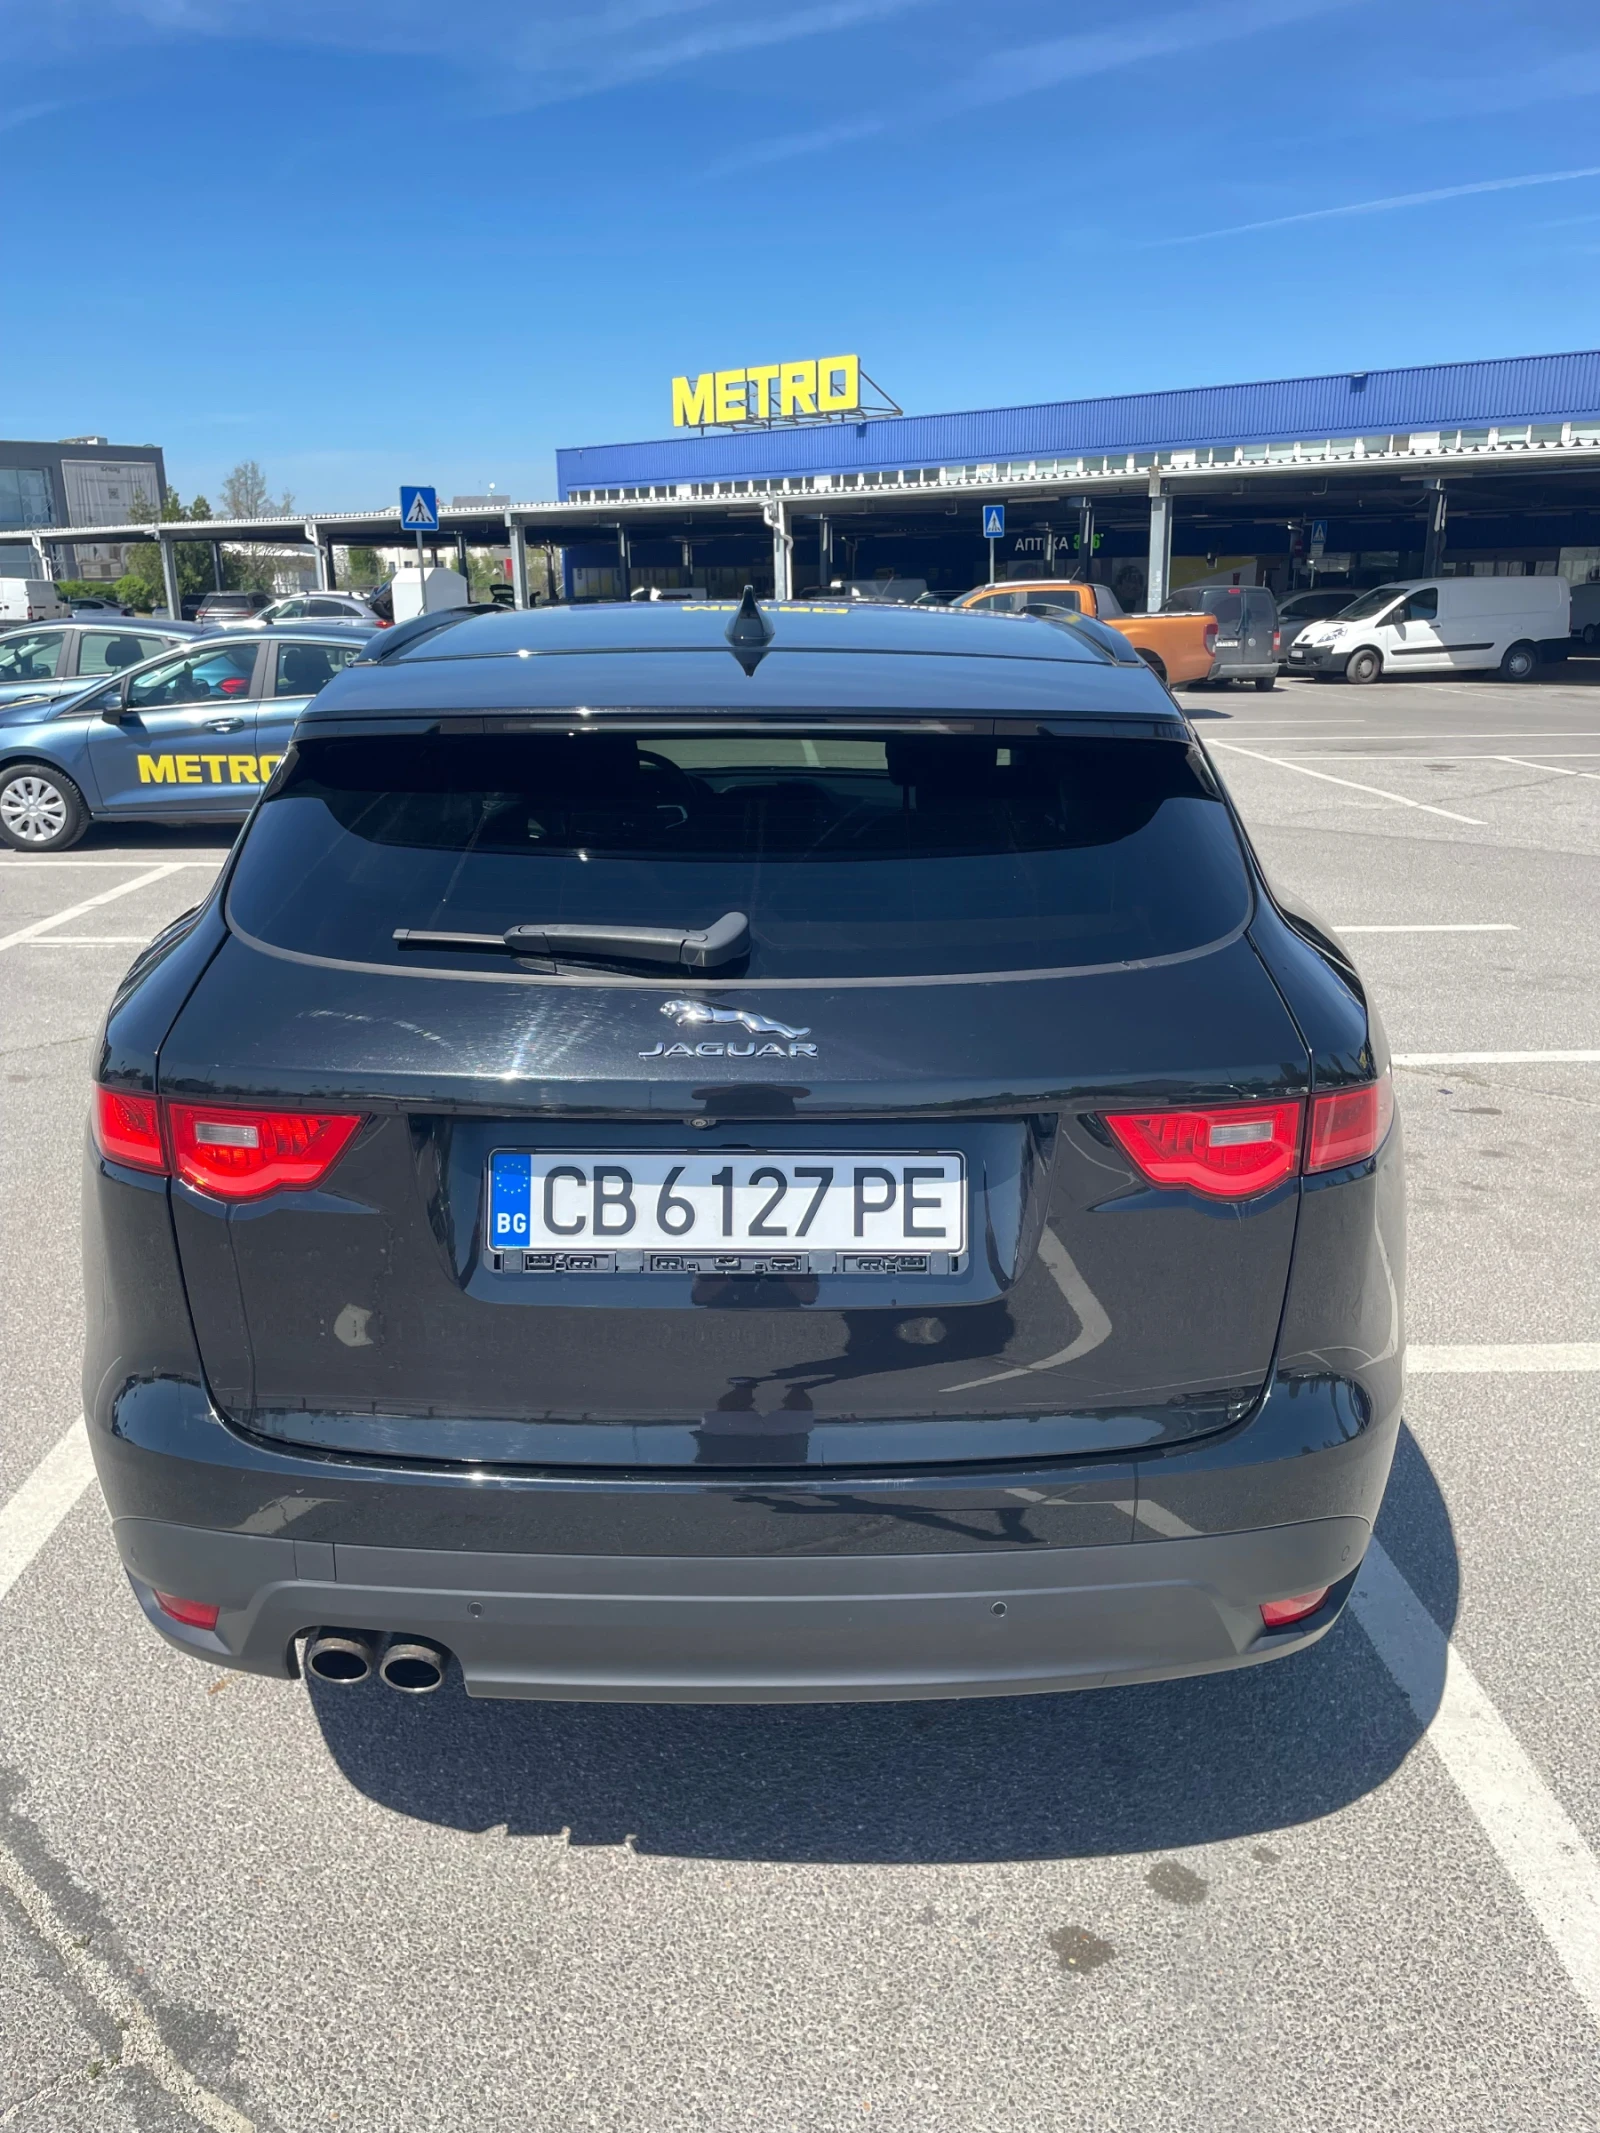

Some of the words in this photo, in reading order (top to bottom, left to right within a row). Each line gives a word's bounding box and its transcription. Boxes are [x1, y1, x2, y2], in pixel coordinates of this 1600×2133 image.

[671, 354, 859, 427] METRO
[1014, 536, 1069, 552] АПТКА
[638, 1042, 818, 1058] JAGUAR
[543, 1165, 636, 1236] CB
[656, 1166, 834, 1237] 6127
[854, 1167, 947, 1238] PE
[497, 1212, 527, 1234] BG
